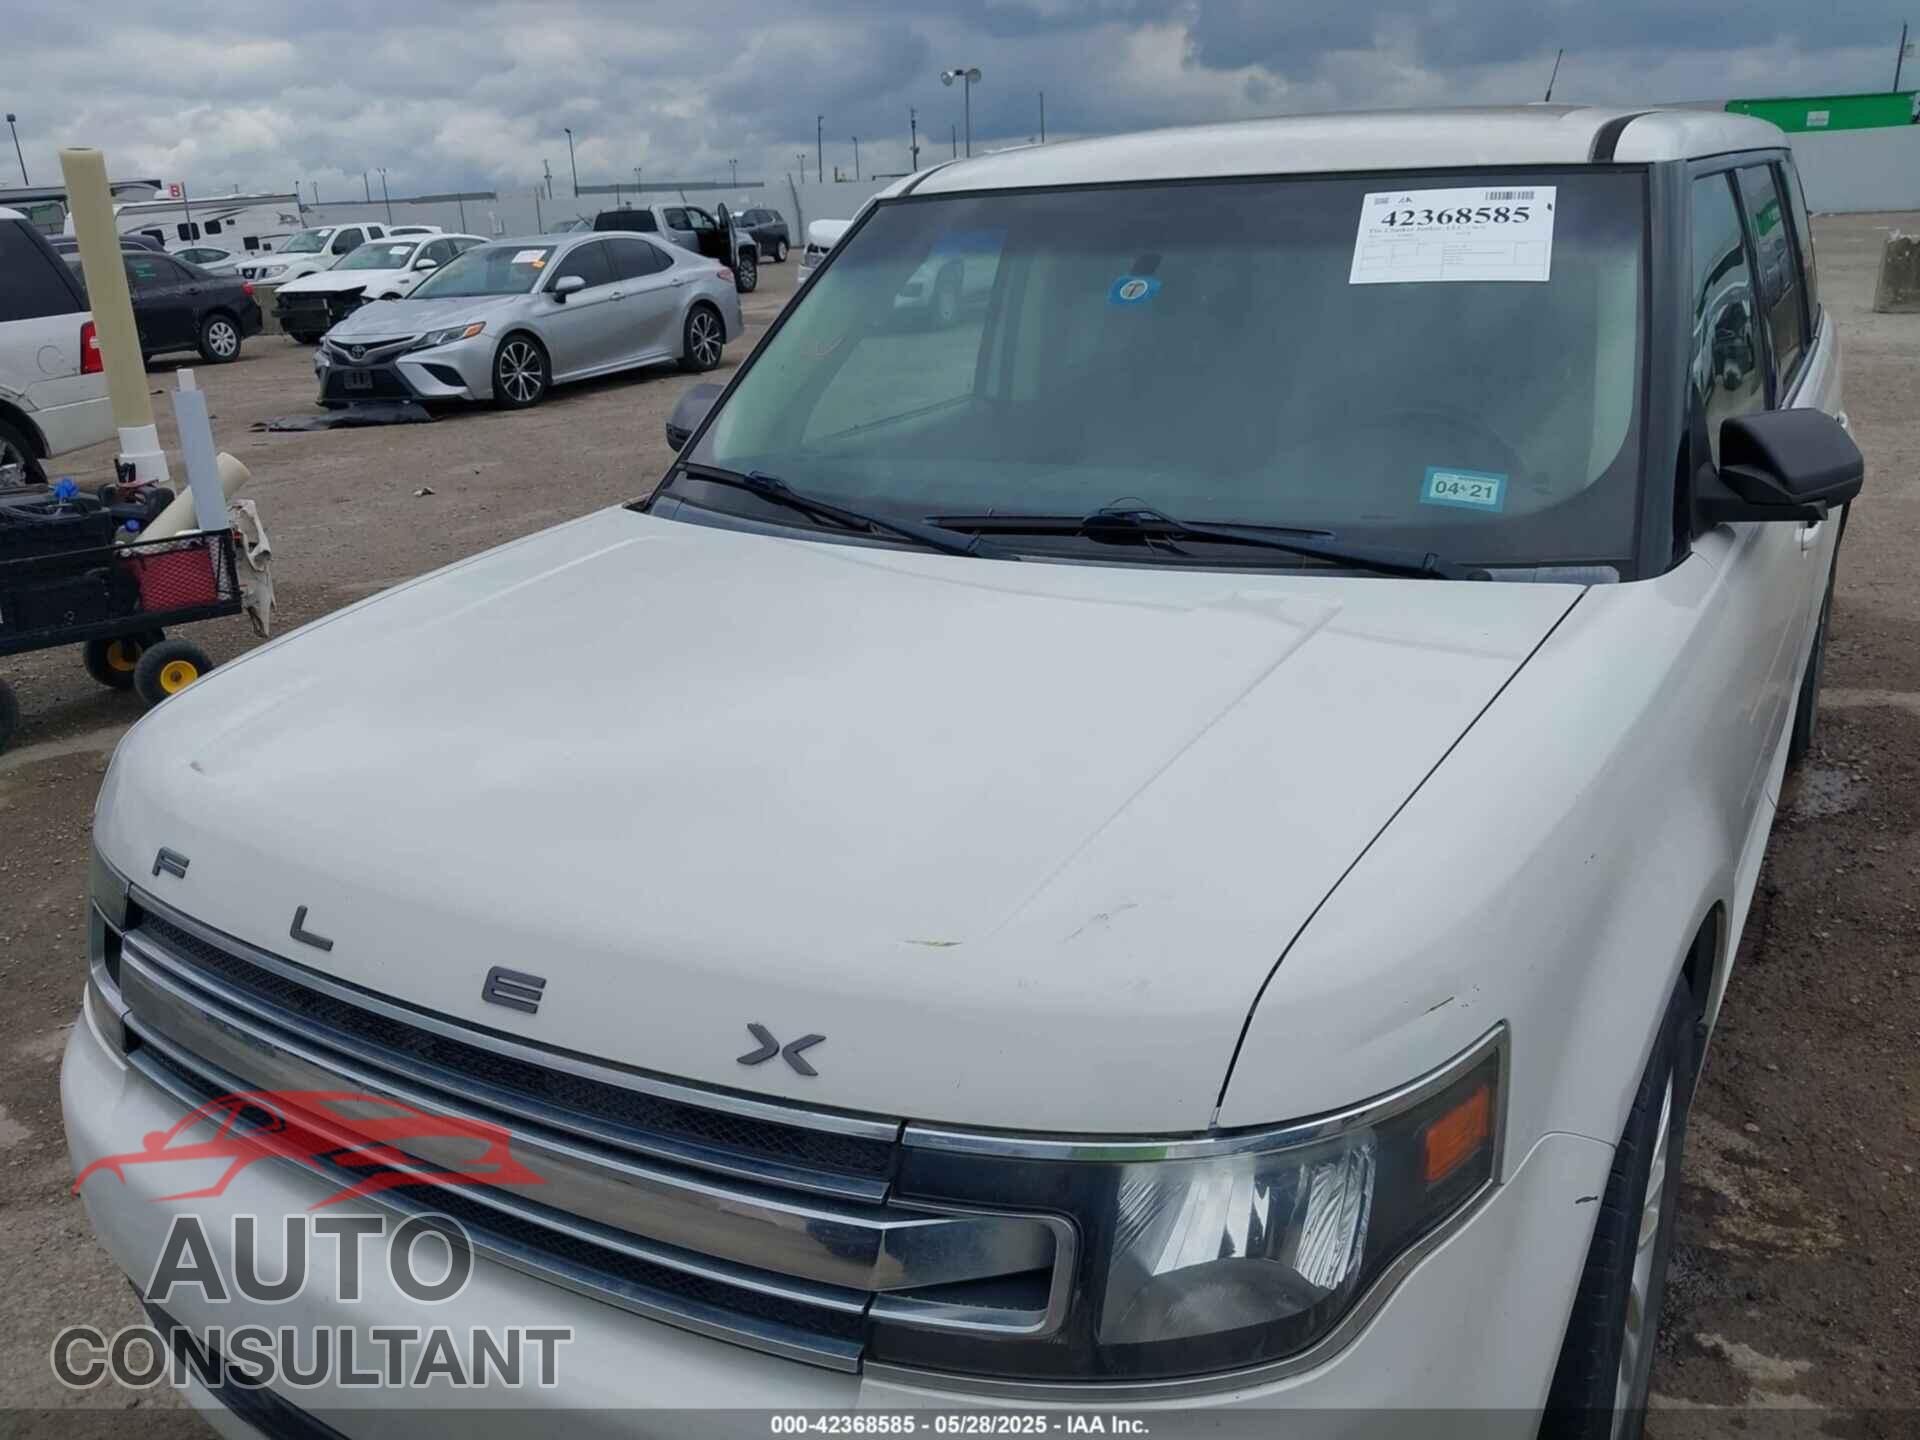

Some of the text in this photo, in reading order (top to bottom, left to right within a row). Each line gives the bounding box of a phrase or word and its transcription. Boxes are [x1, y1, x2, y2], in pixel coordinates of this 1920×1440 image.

[170, 184, 181, 198] B
[1381, 206, 1532, 227] 42368585
[1469, 484, 1493, 499] 21
